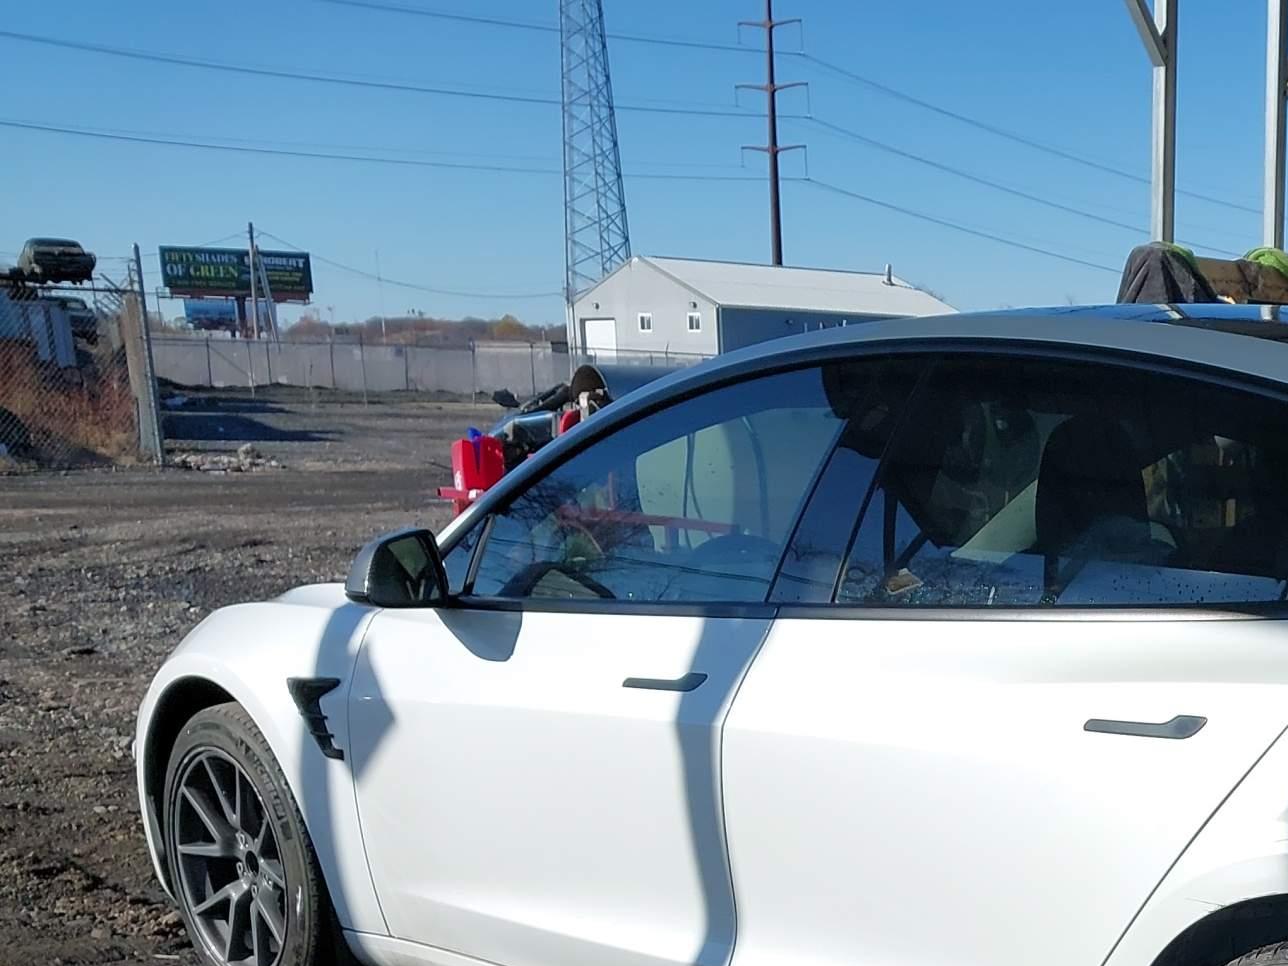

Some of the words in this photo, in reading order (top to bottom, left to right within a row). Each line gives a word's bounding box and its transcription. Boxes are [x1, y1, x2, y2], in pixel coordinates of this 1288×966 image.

[165, 251, 193, 263] FIFTY
[195, 253, 238, 264] SHADES
[166, 263, 187, 276] OF
[189, 264, 239, 278] GREEN
